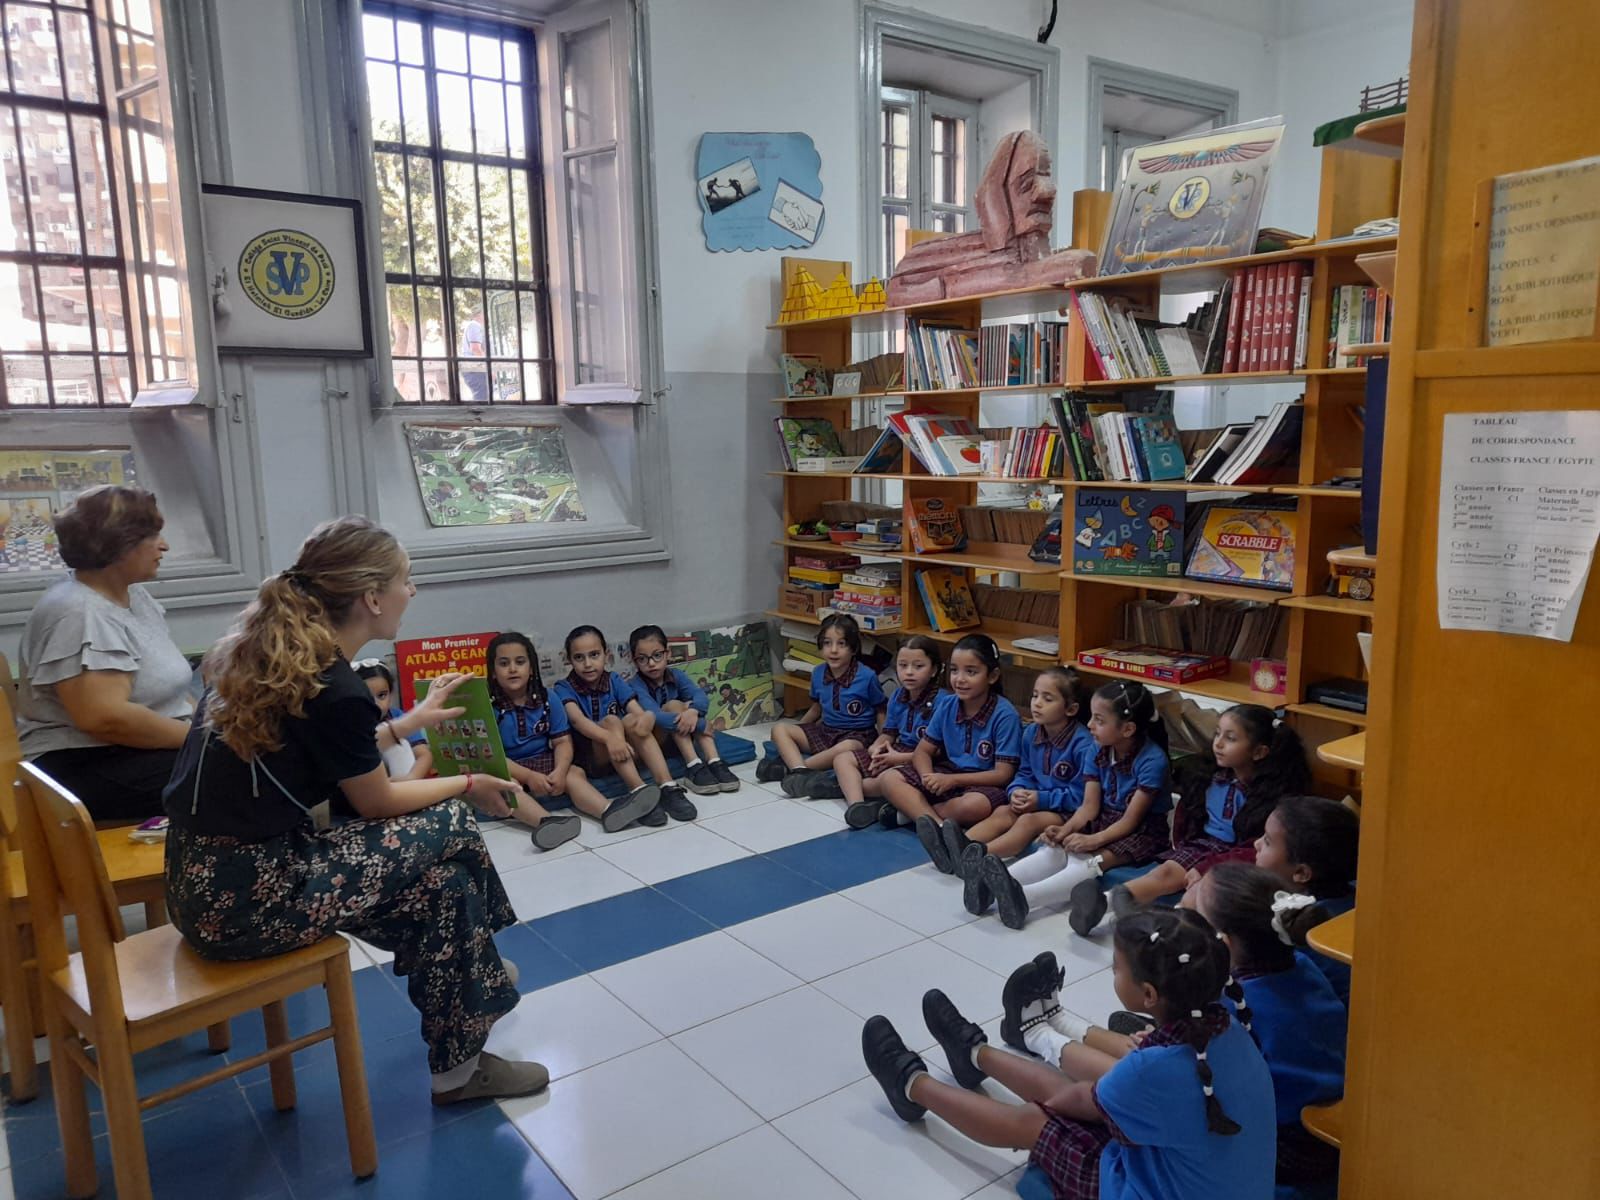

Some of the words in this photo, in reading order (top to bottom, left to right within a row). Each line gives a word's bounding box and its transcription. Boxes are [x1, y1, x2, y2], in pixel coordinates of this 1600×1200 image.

[282, 235, 310, 247] Vincent
[1487, 437, 1577, 445] CORRESPONDANCE
[1558, 457, 1594, 465] EGYPTE
[1497, 485, 1525, 493] France
[1538, 487, 1567, 495] Classes
[1100, 530, 1117, 546] A
[1120, 524, 1132, 539] B
[1132, 518, 1142, 529] C
[1219, 534, 1279, 550] SCRABBLE
[422, 640, 442, 650] Mon
[444, 637, 480, 649] Premier
[406, 651, 446, 665] ATLAS
[451, 647, 487, 660] GEAN
[1101, 658, 1118, 669] DOTS
[413, 665, 487, 679] L'EUROP
